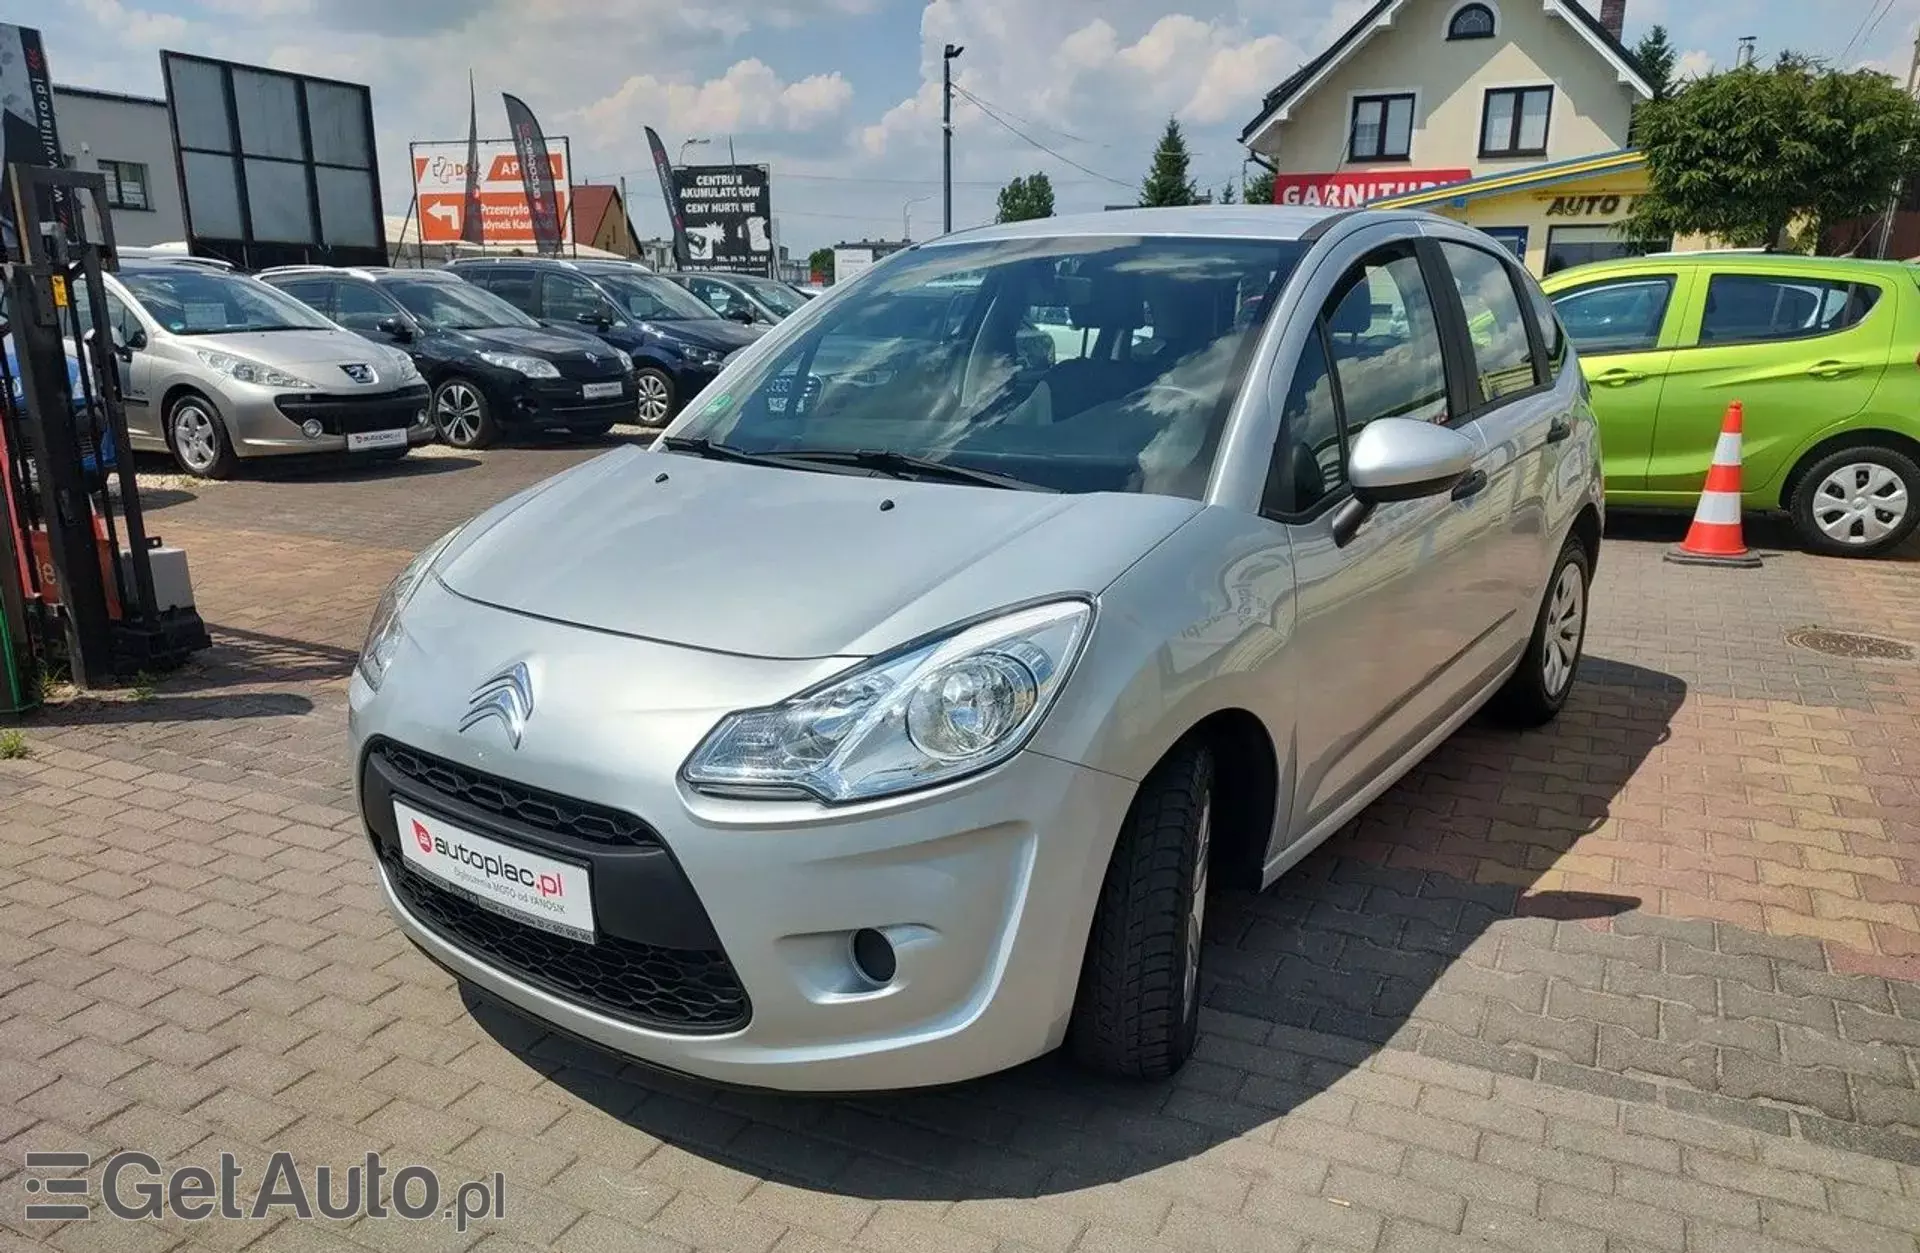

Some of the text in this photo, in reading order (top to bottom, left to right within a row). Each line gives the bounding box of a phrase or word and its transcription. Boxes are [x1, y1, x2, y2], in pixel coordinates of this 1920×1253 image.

[696, 174, 743, 186] CENTRUM
[685, 203, 709, 213] CENY
[1545, 194, 1621, 217] AUTO
[434, 836, 563, 897] autoplac.pl
